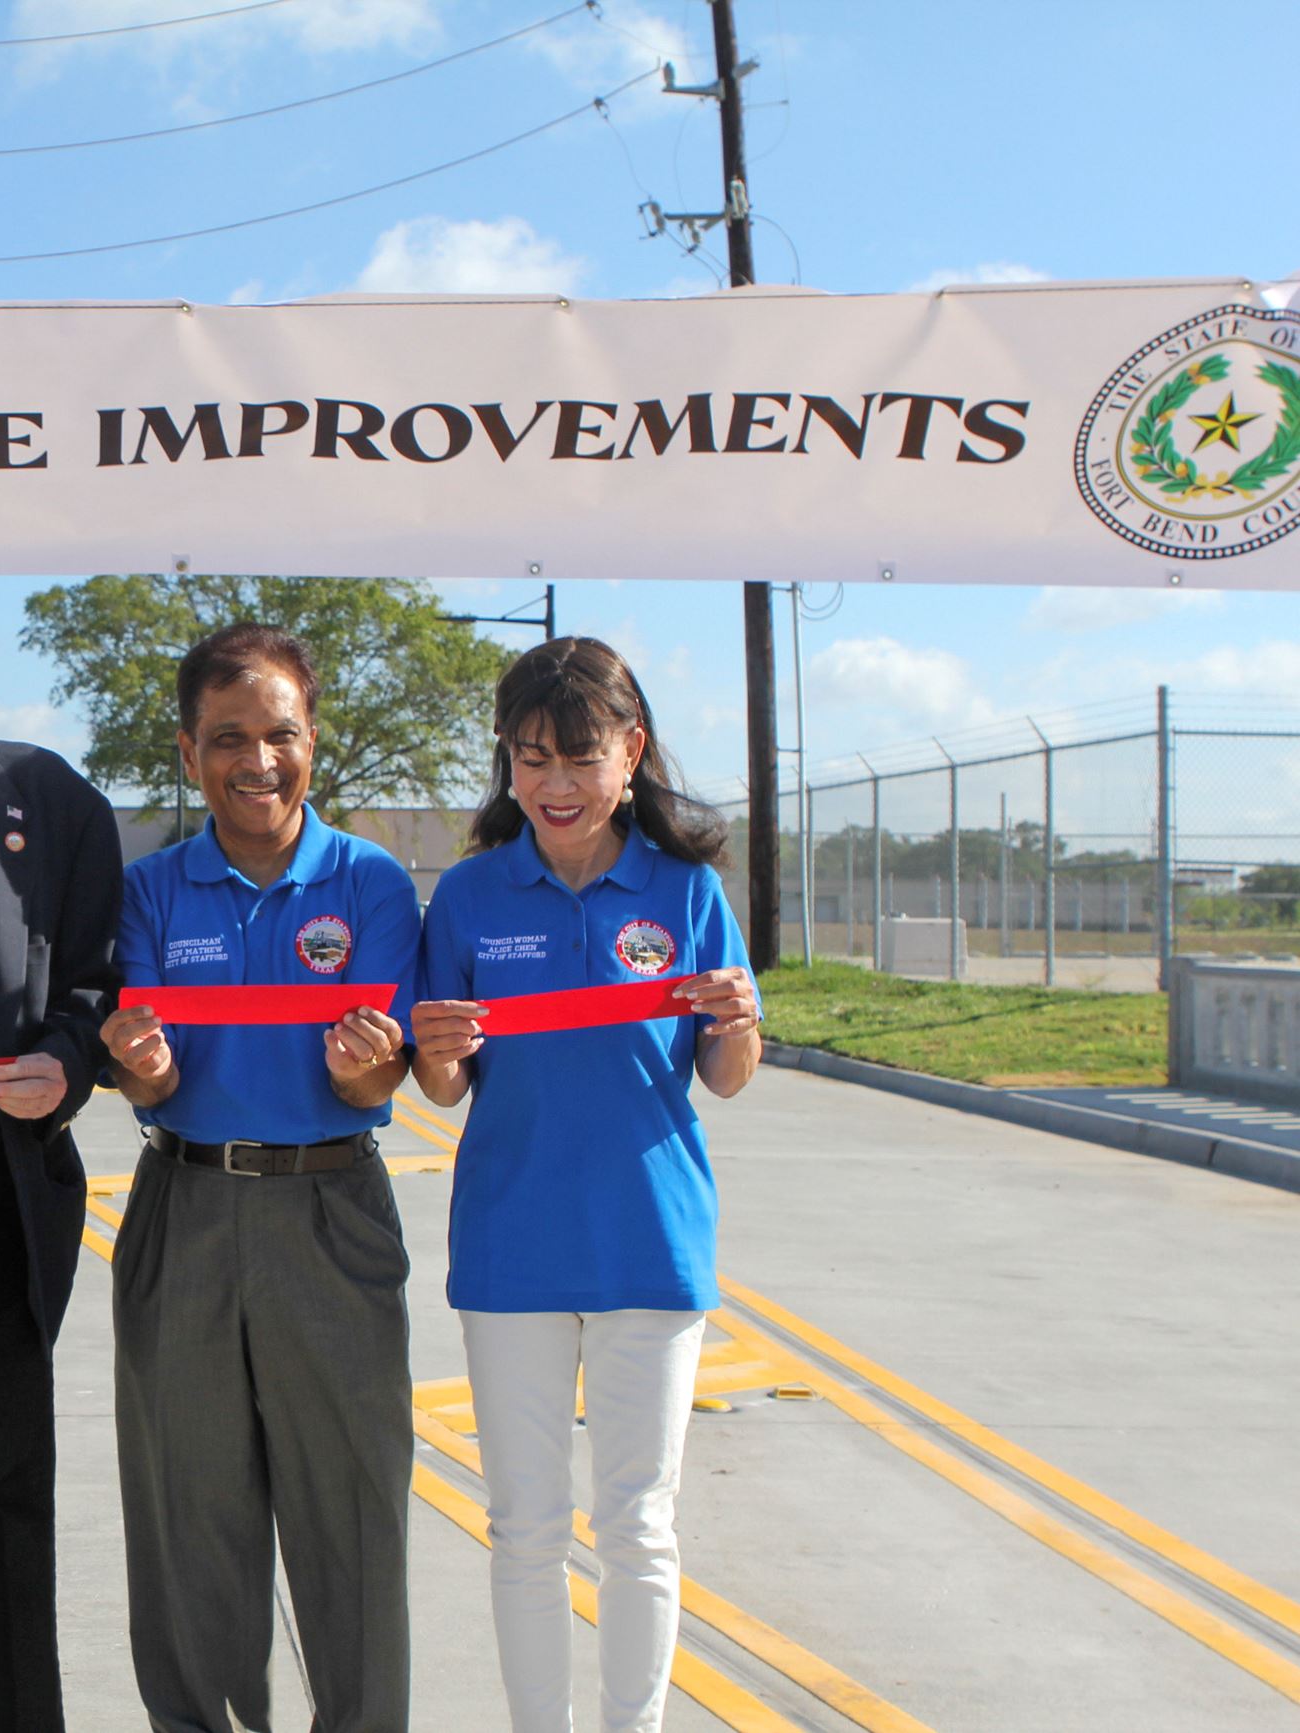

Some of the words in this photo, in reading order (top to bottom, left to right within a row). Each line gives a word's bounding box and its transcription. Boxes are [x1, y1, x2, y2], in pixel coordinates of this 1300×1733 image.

[1106, 367, 1152, 415] THE
[1163, 318, 1248, 361] STATE
[96, 392, 1030, 467] IMPROVEMENTS
[1091, 458, 1135, 512] FORT
[1142, 512, 1219, 544] BEND
[1242, 484, 1300, 535] COU
[168, 937, 221, 950] COUNCILMAN
[479, 934, 547, 946] COUNCILWOMAN
[185, 945, 223, 956] MATHEW
[488, 945, 513, 954] ALICE
[190, 952, 229, 963] STAFFORD
[478, 951, 496, 961] CITY
[507, 951, 547, 960] STAFFORD
